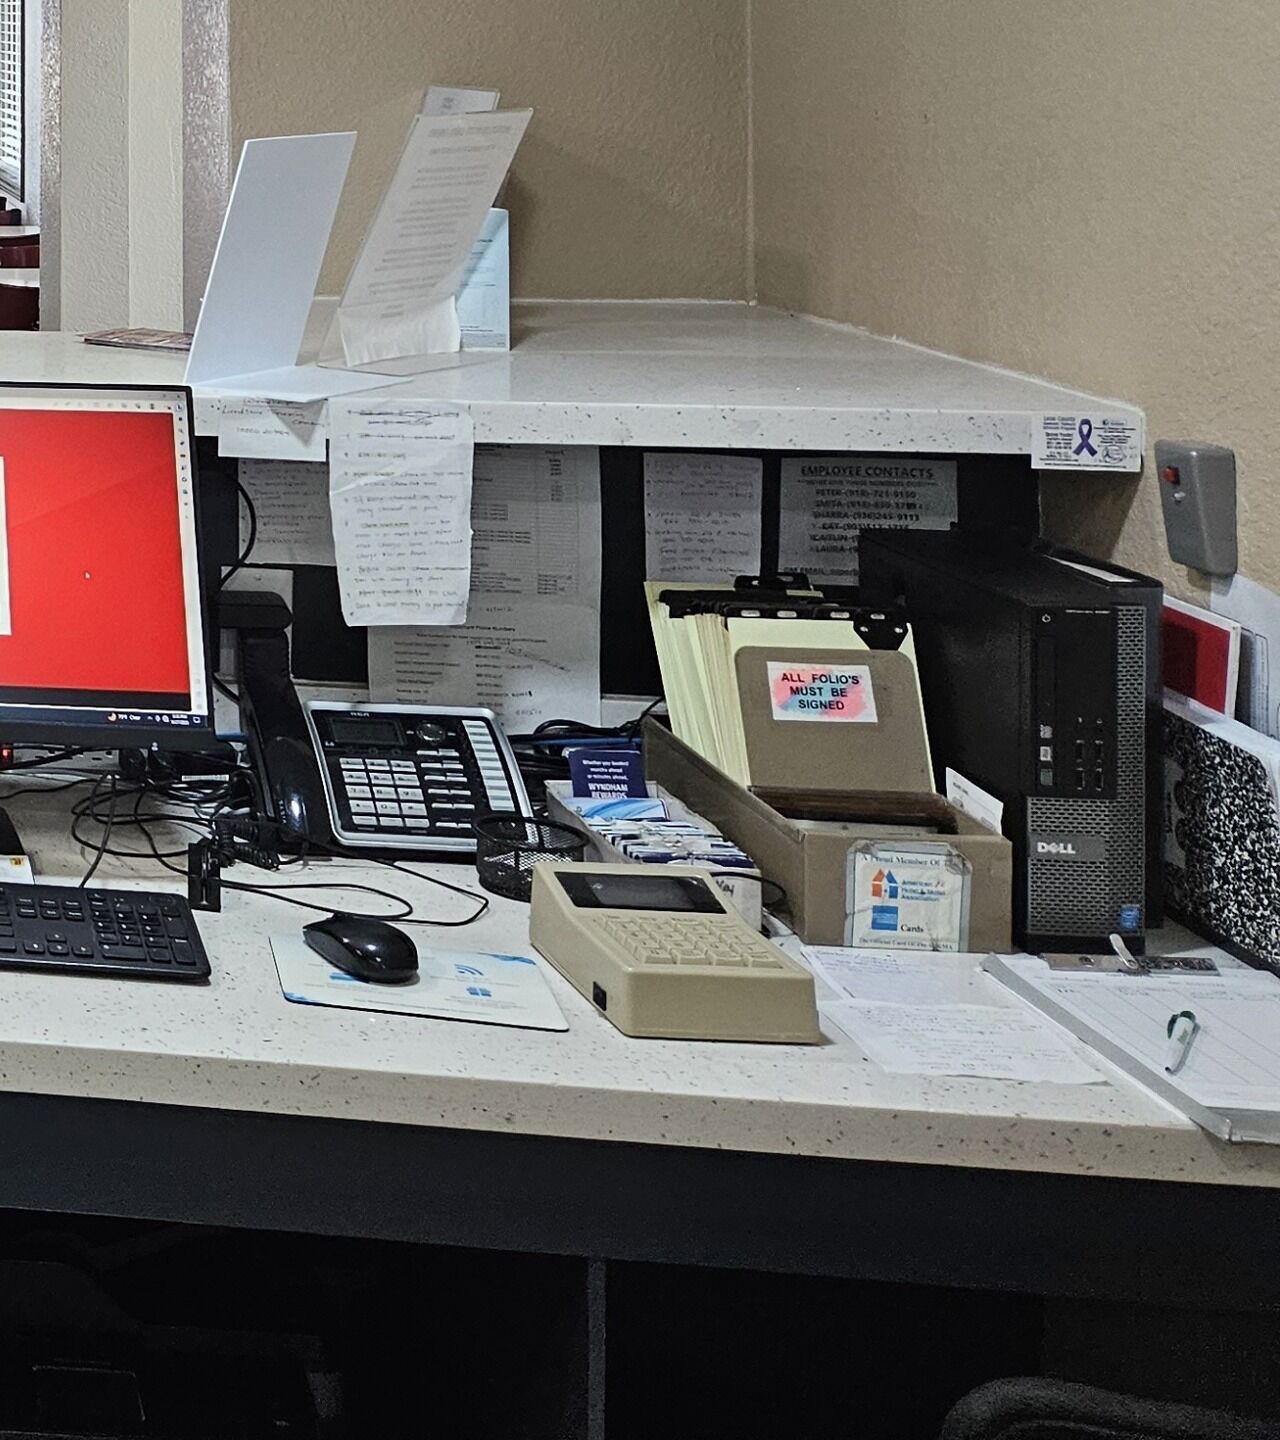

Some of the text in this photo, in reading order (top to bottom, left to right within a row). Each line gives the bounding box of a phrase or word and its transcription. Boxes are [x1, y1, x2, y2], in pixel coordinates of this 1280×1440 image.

[800, 465, 933, 478] EMPLOYEE CONTACTS
[780, 672, 859, 684] ALL FOLIO'S
[789, 685, 847, 697] MUST BE
[797, 698, 844, 710] SIGNED
[587, 782, 628, 792] WYNDHAM
[1036, 841, 1076, 854] DELL
[899, 923, 924, 933] Cards
